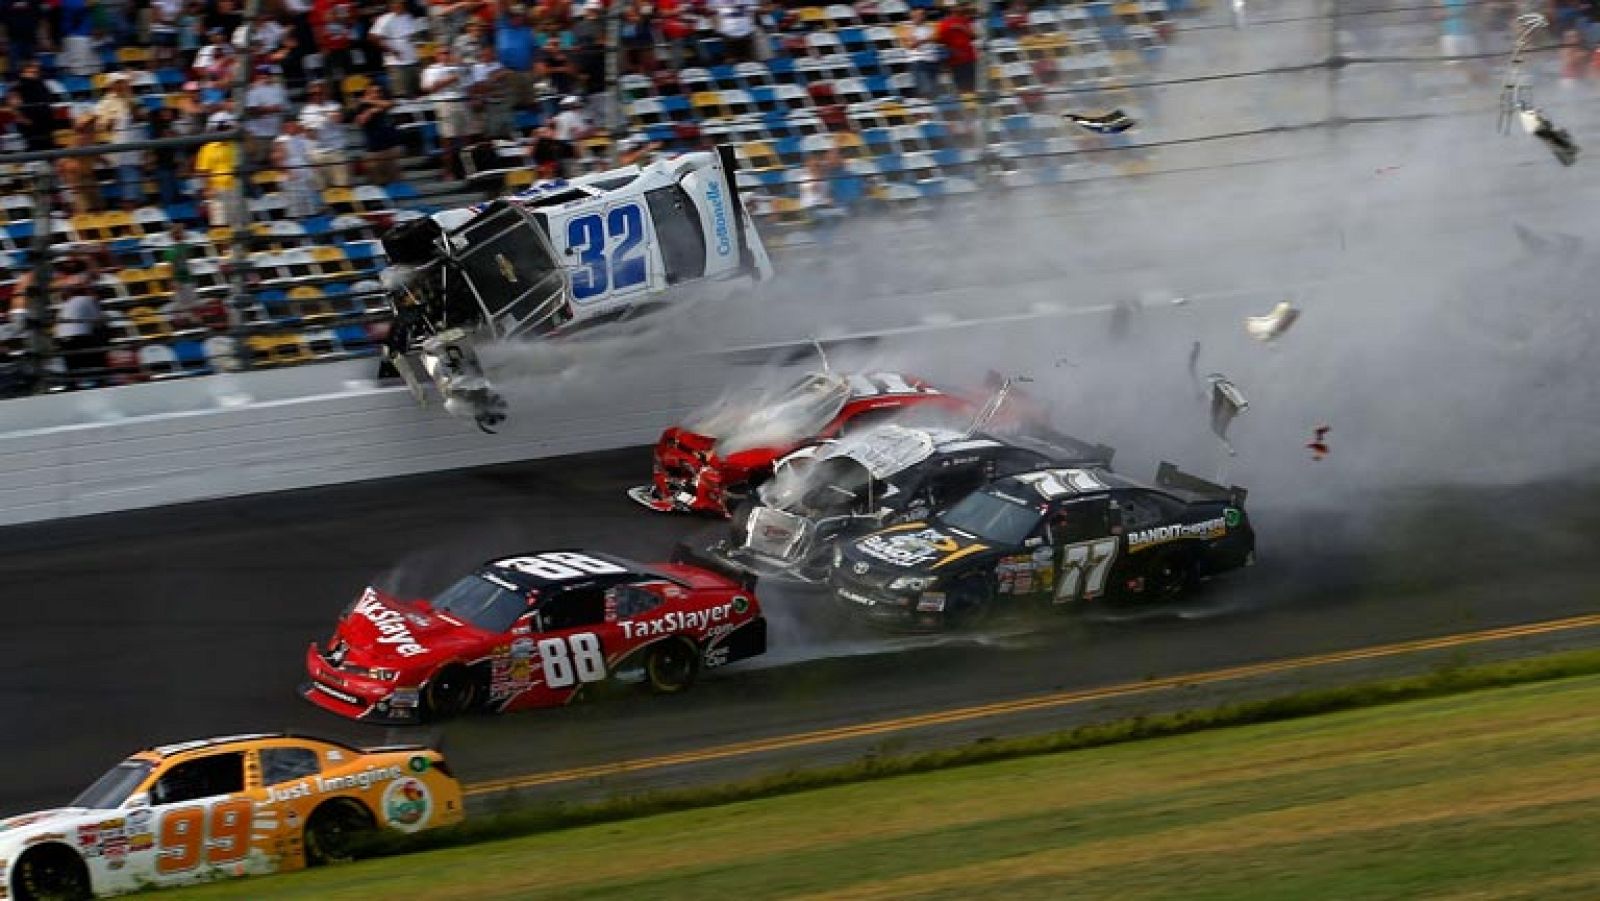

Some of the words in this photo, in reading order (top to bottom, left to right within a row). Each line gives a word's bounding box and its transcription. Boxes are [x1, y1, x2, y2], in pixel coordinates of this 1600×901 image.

[706, 180, 731, 257] Cottonelle
[567, 203, 648, 300] 32
[1010, 468, 1113, 500] 77
[1128, 523, 1182, 546] BANDIT
[492, 552, 631, 580] 88
[1053, 536, 1120, 604] 77
[616, 602, 732, 640] TaxSlayer
[537, 631, 607, 688] 88
[267, 782, 311, 802] Just
[315, 764, 402, 790] Imagine
[155, 801, 251, 874] 99
